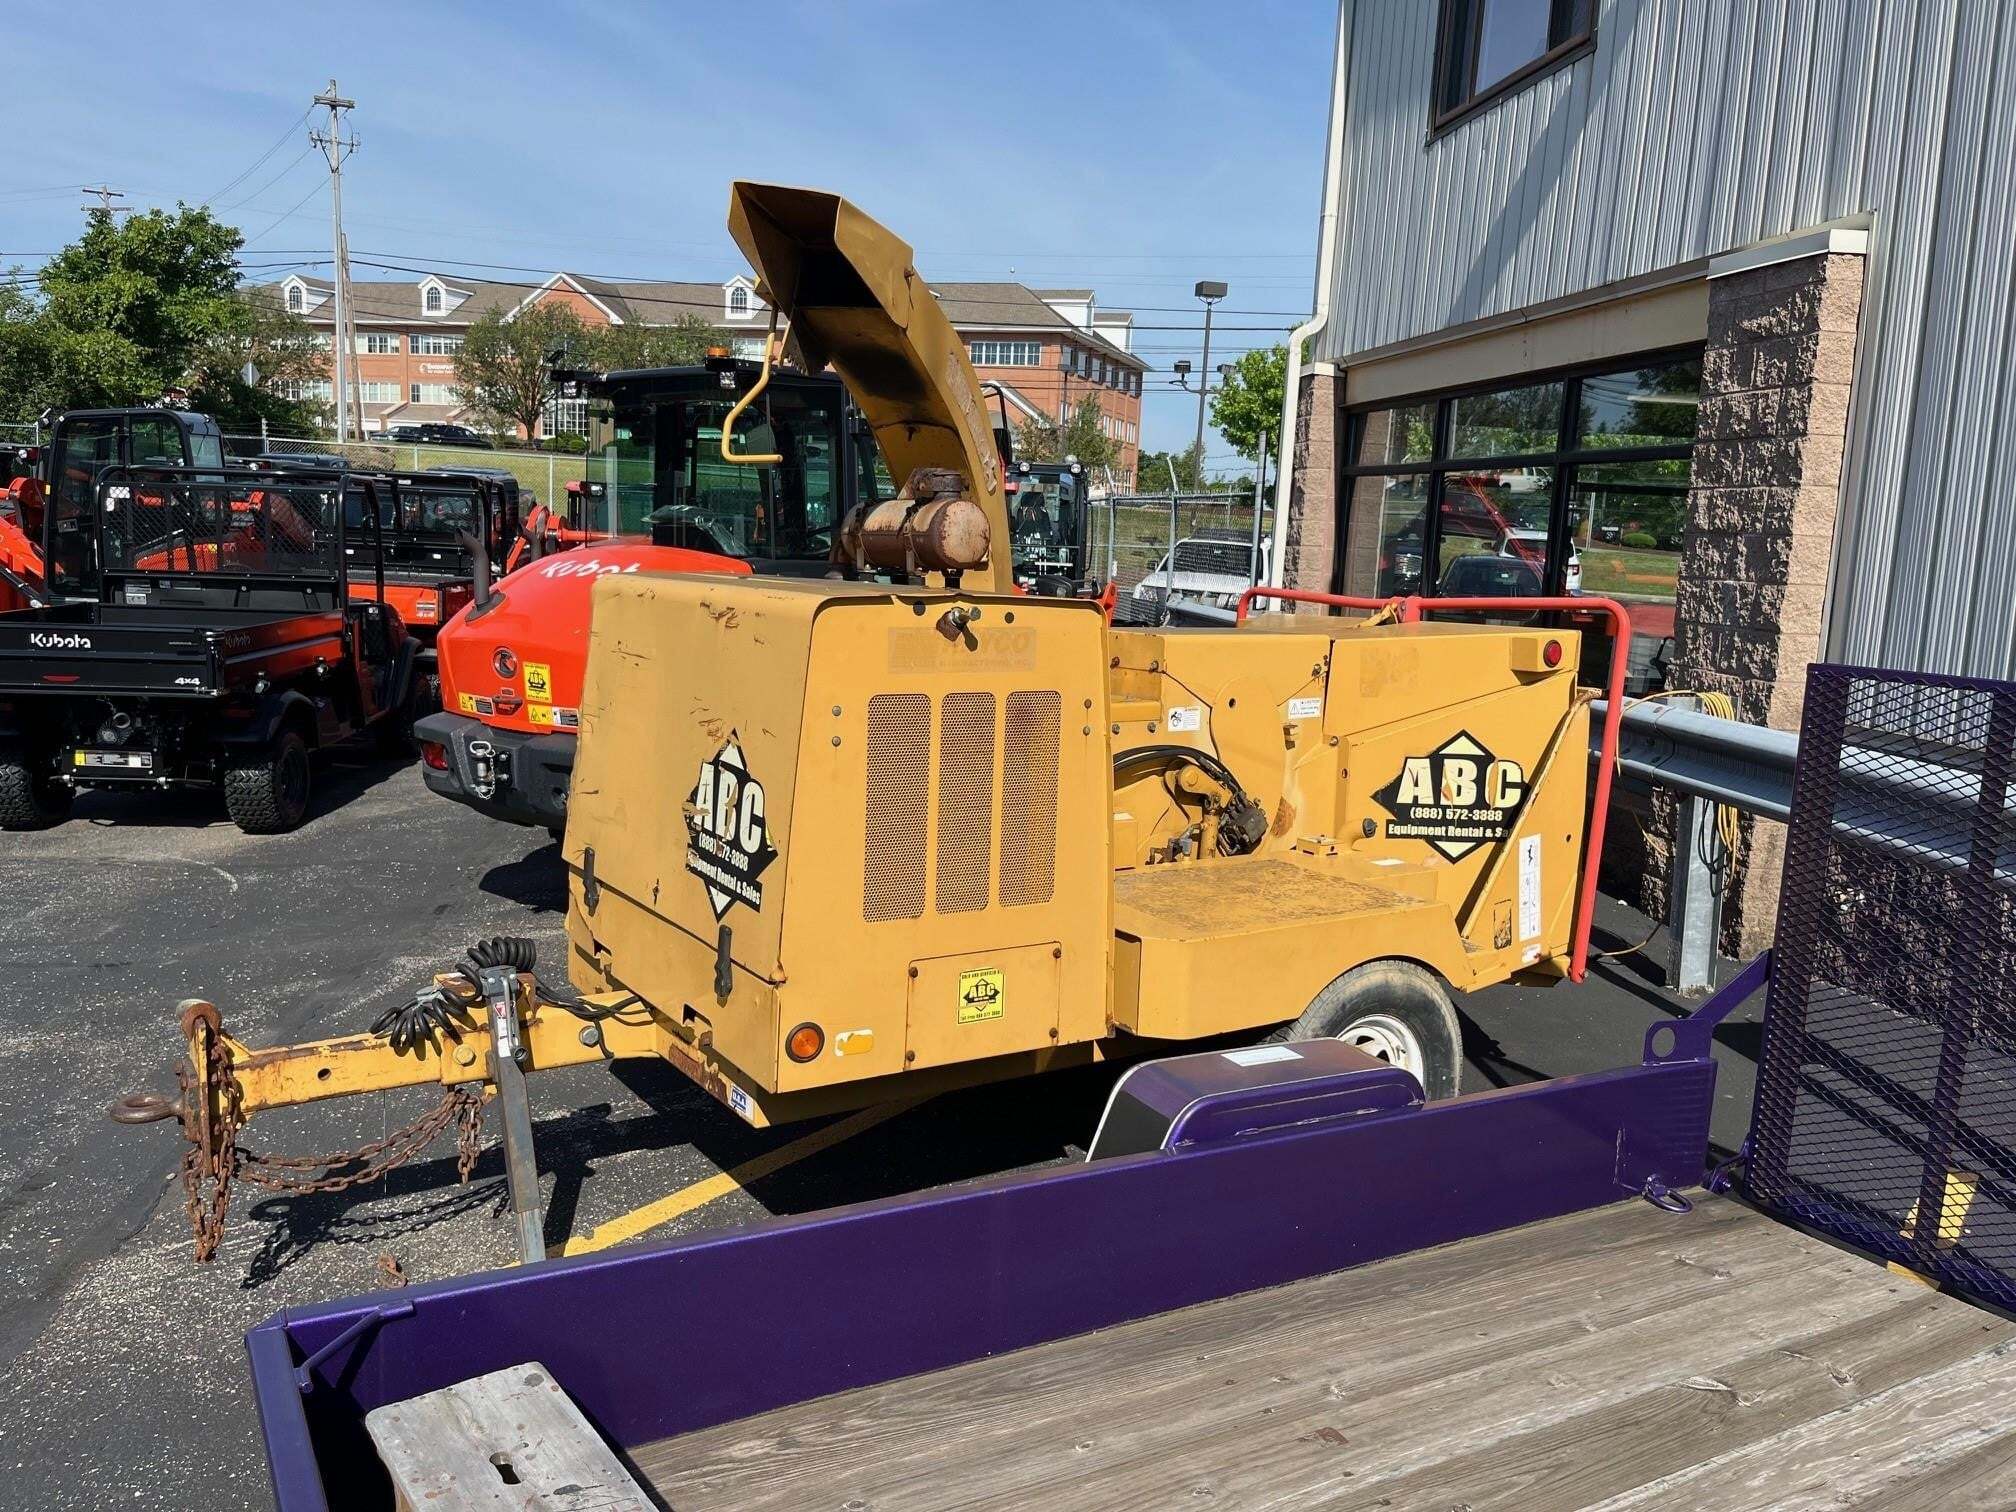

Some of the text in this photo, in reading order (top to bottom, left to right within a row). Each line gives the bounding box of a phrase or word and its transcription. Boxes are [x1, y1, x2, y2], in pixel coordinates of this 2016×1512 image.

[541, 560, 640, 578] Kubot
[31, 633, 91, 648] Kubota
[174, 677, 201, 686] 4x4
[1396, 758, 1522, 809] ABC
[694, 762, 765, 853] ABC
[1410, 807, 1503, 821] (888) 572-3888
[1388, 824, 1446, 837] Equipment
[1448, 825, 1483, 838] Rental
[1486, 828, 1493, 838] &
[699, 832, 749, 872] (888) 72-3888
[717, 867, 736, 891] Rental
[736, 881, 742, 894] &
[742, 882, 760, 905] Sales
[969, 983, 996, 998] ABC
